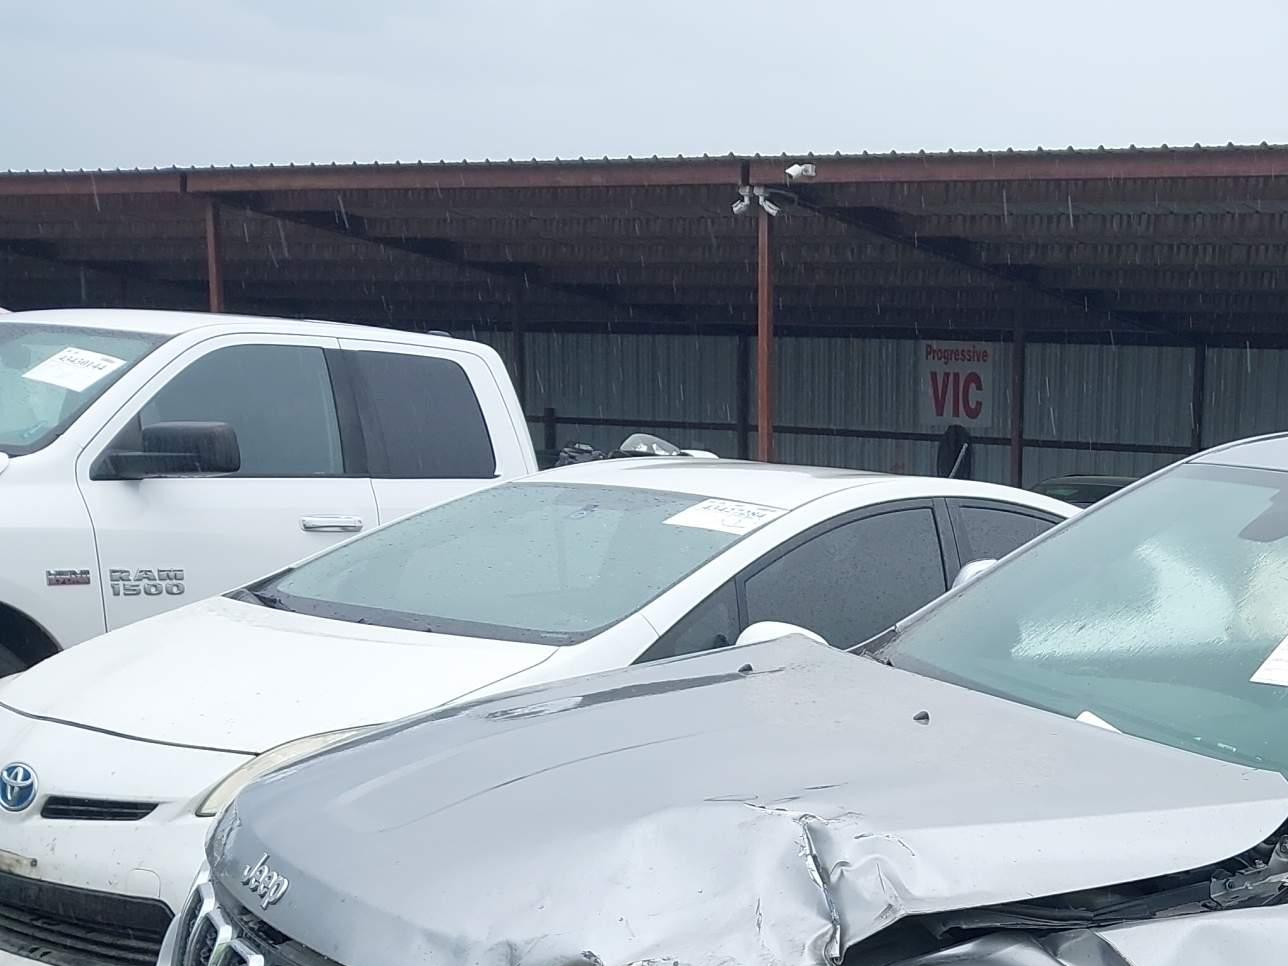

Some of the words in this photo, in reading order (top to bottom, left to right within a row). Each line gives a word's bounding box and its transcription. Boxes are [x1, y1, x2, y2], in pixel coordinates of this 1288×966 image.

[926, 344, 988, 365] Progressive
[930, 371, 984, 419] VIC
[110, 569, 184, 582] RAM
[111, 583, 185, 596] 1500
[241, 852, 289, 911] Jeep
